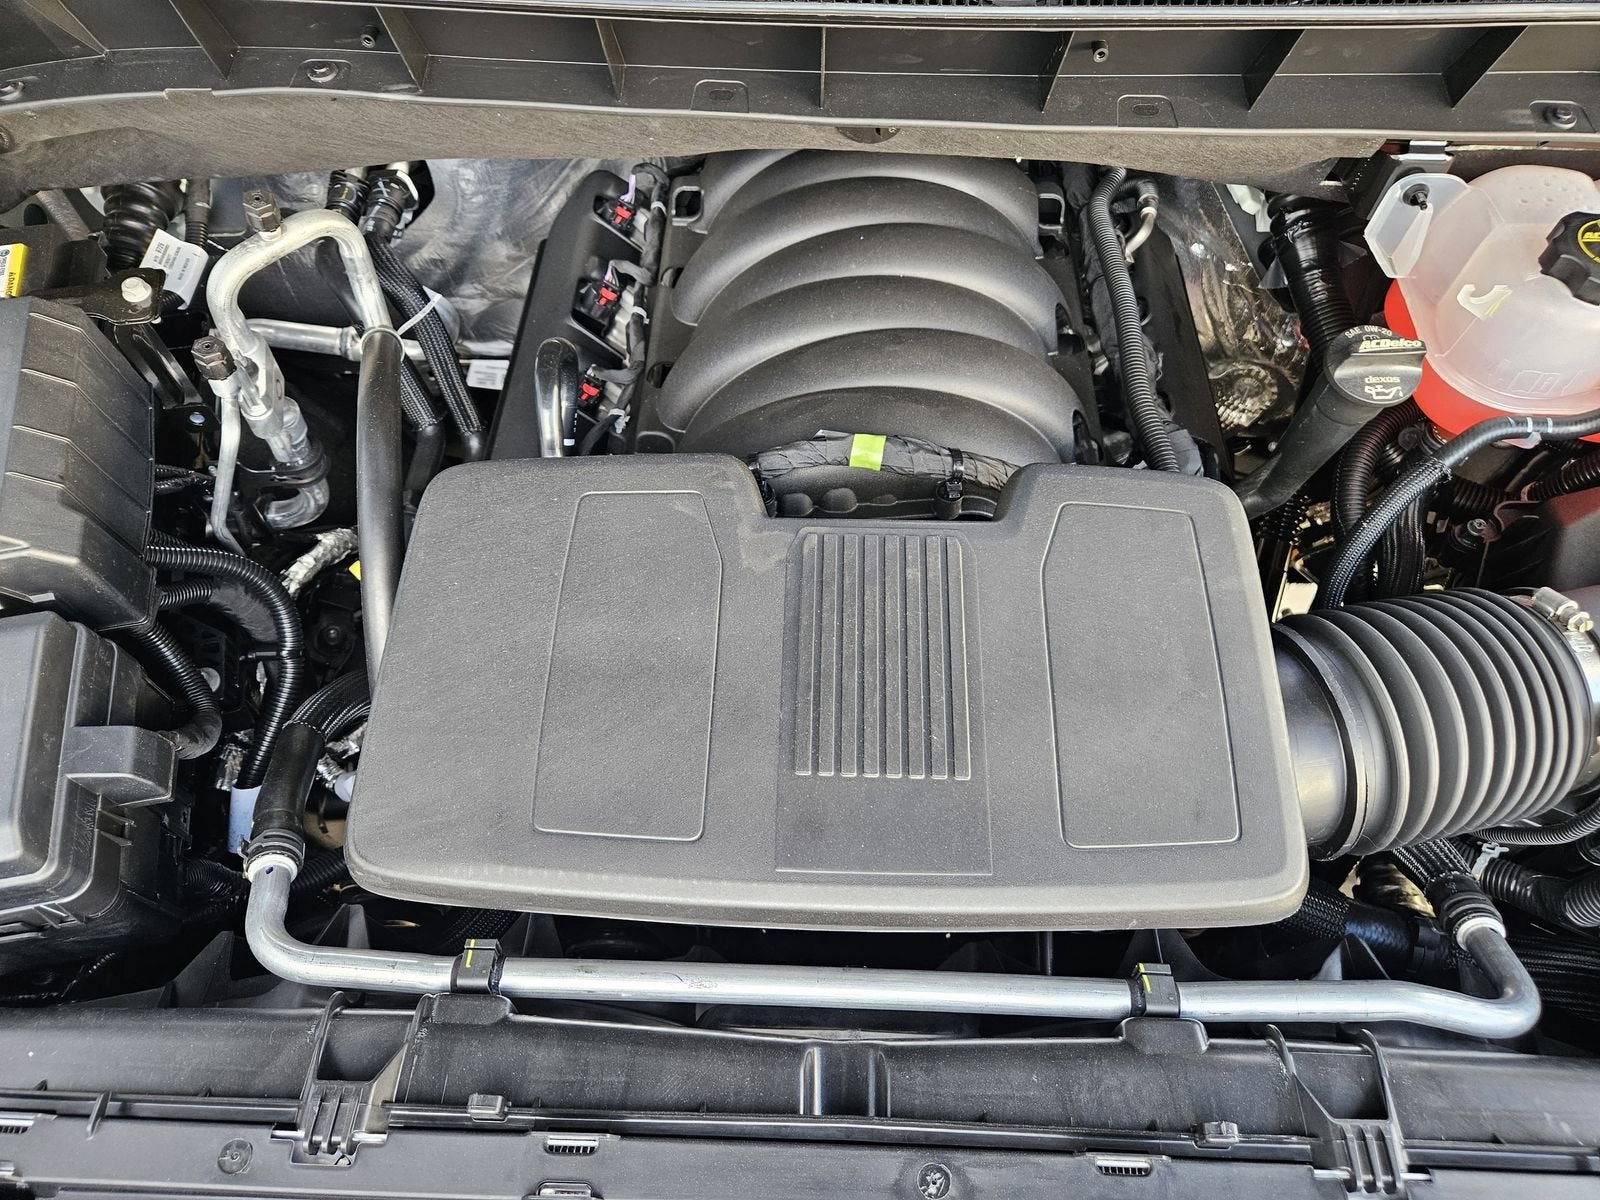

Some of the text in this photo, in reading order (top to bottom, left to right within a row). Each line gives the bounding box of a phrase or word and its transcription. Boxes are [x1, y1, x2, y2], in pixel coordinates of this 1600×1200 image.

[1345, 325, 1393, 339] SAE 0W-20
[1359, 338, 1422, 351] ACDelco
[1364, 375, 1401, 384] dexos
